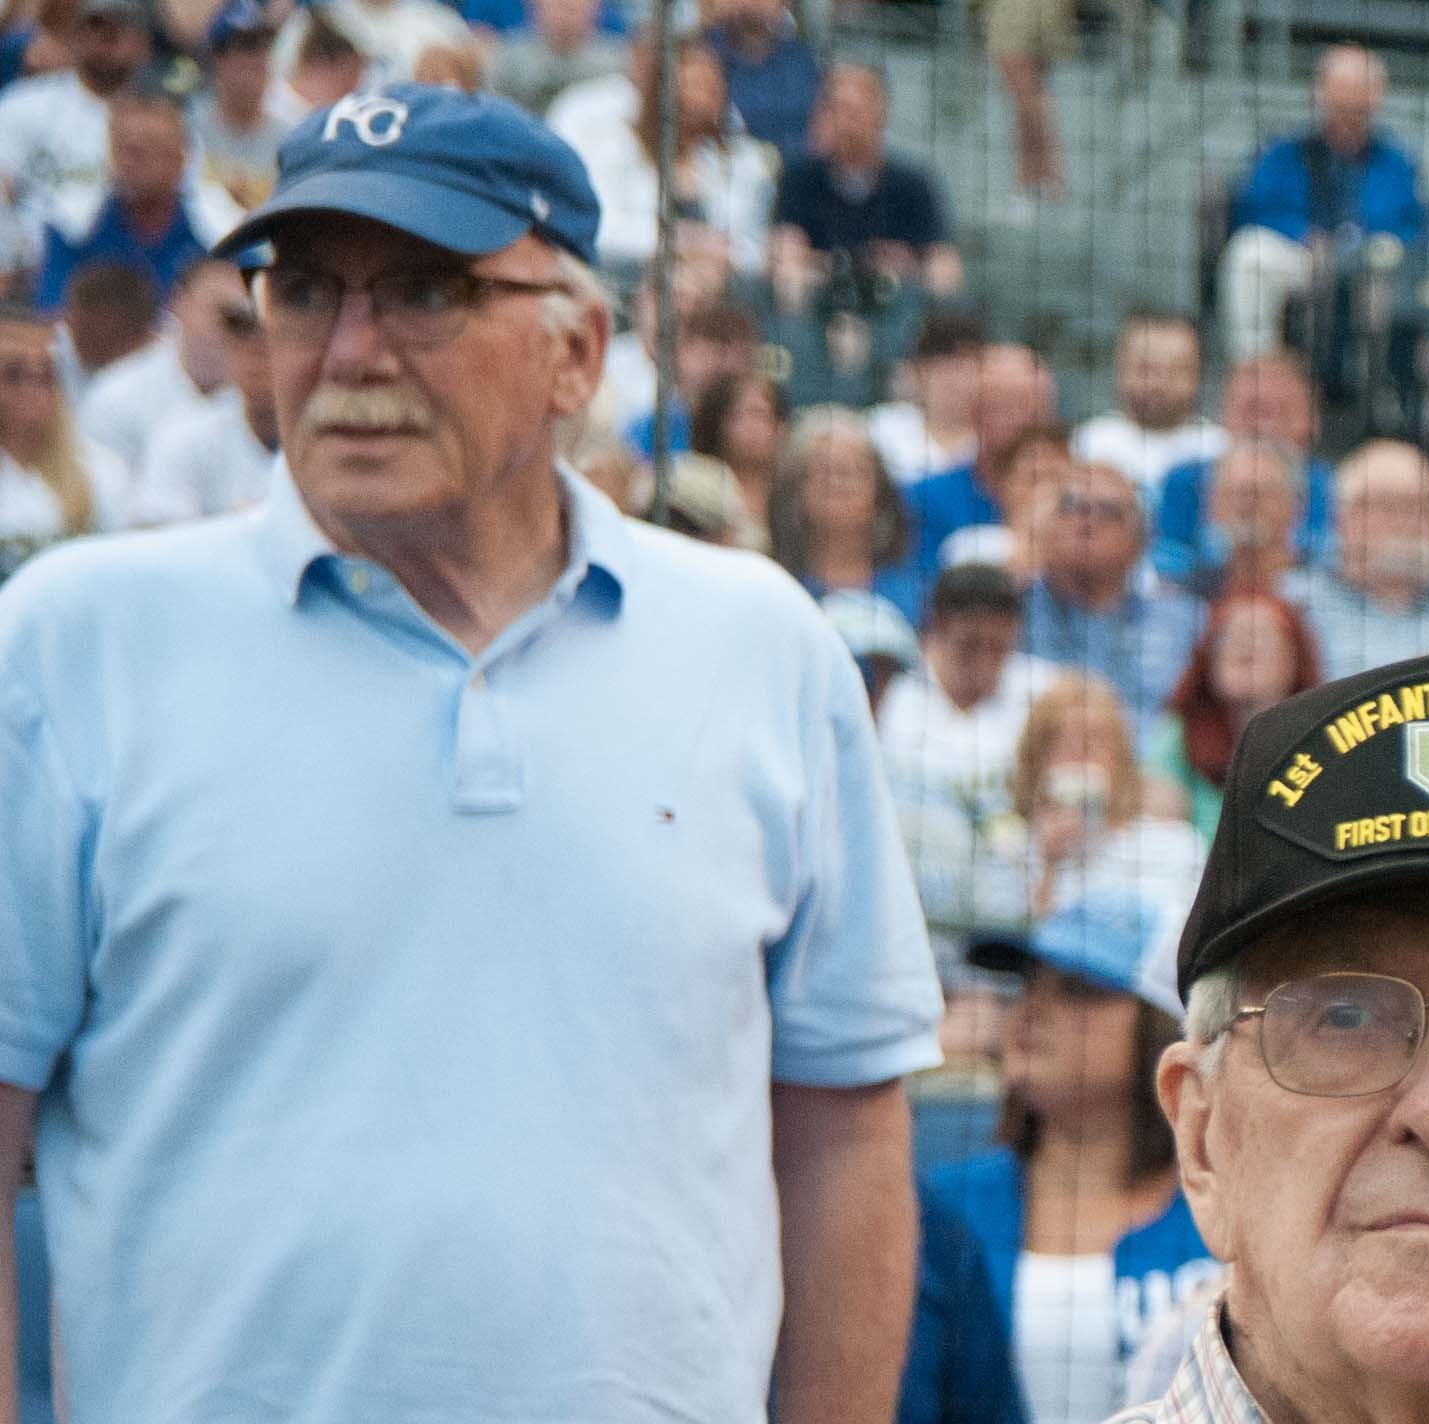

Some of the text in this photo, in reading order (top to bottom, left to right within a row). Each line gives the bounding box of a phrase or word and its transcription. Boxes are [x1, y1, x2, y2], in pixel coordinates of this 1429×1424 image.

[322, 94, 409, 147] KC
[1266, 752, 1324, 809] 1st
[1335, 813, 1407, 850] FIRST
